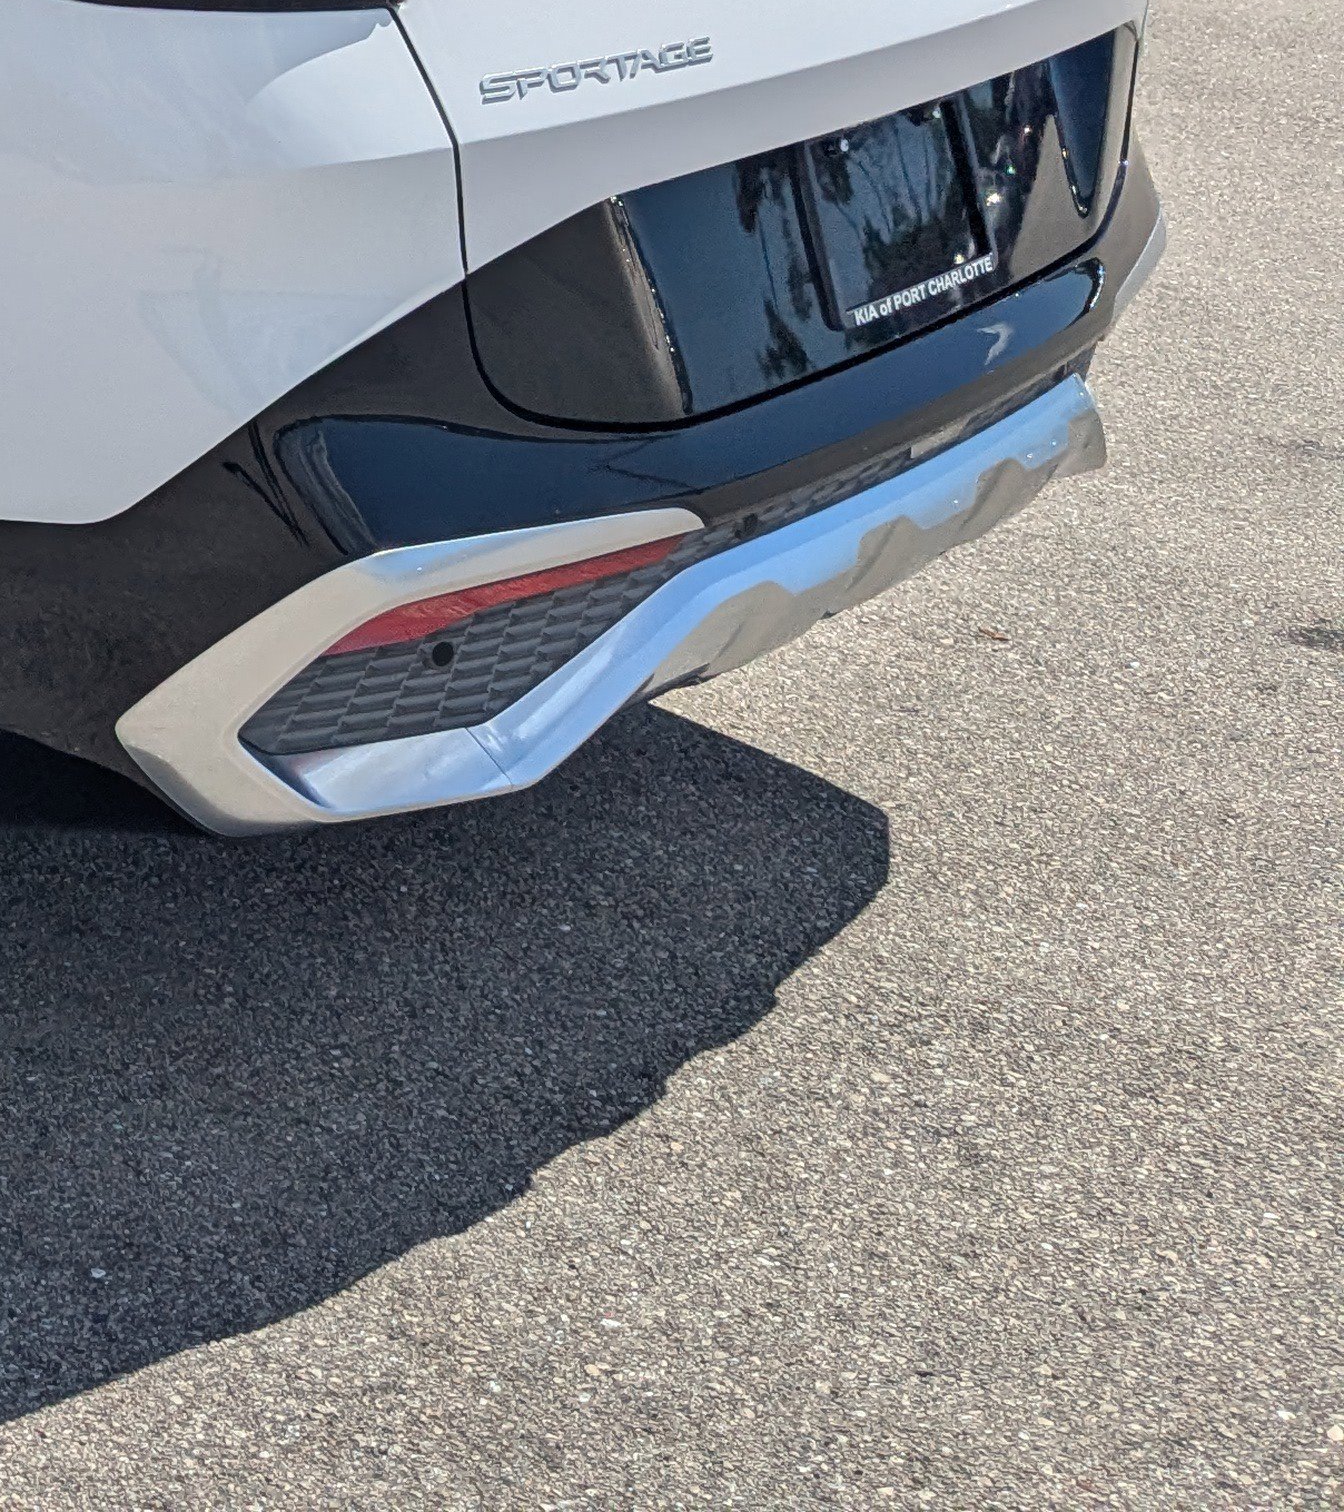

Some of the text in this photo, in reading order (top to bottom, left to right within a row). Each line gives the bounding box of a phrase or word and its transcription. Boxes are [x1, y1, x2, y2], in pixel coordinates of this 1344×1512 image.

[479, 36, 714, 105] SPORTAGE
[854, 257, 993, 326] KIA of PORT CHARLOTTE
